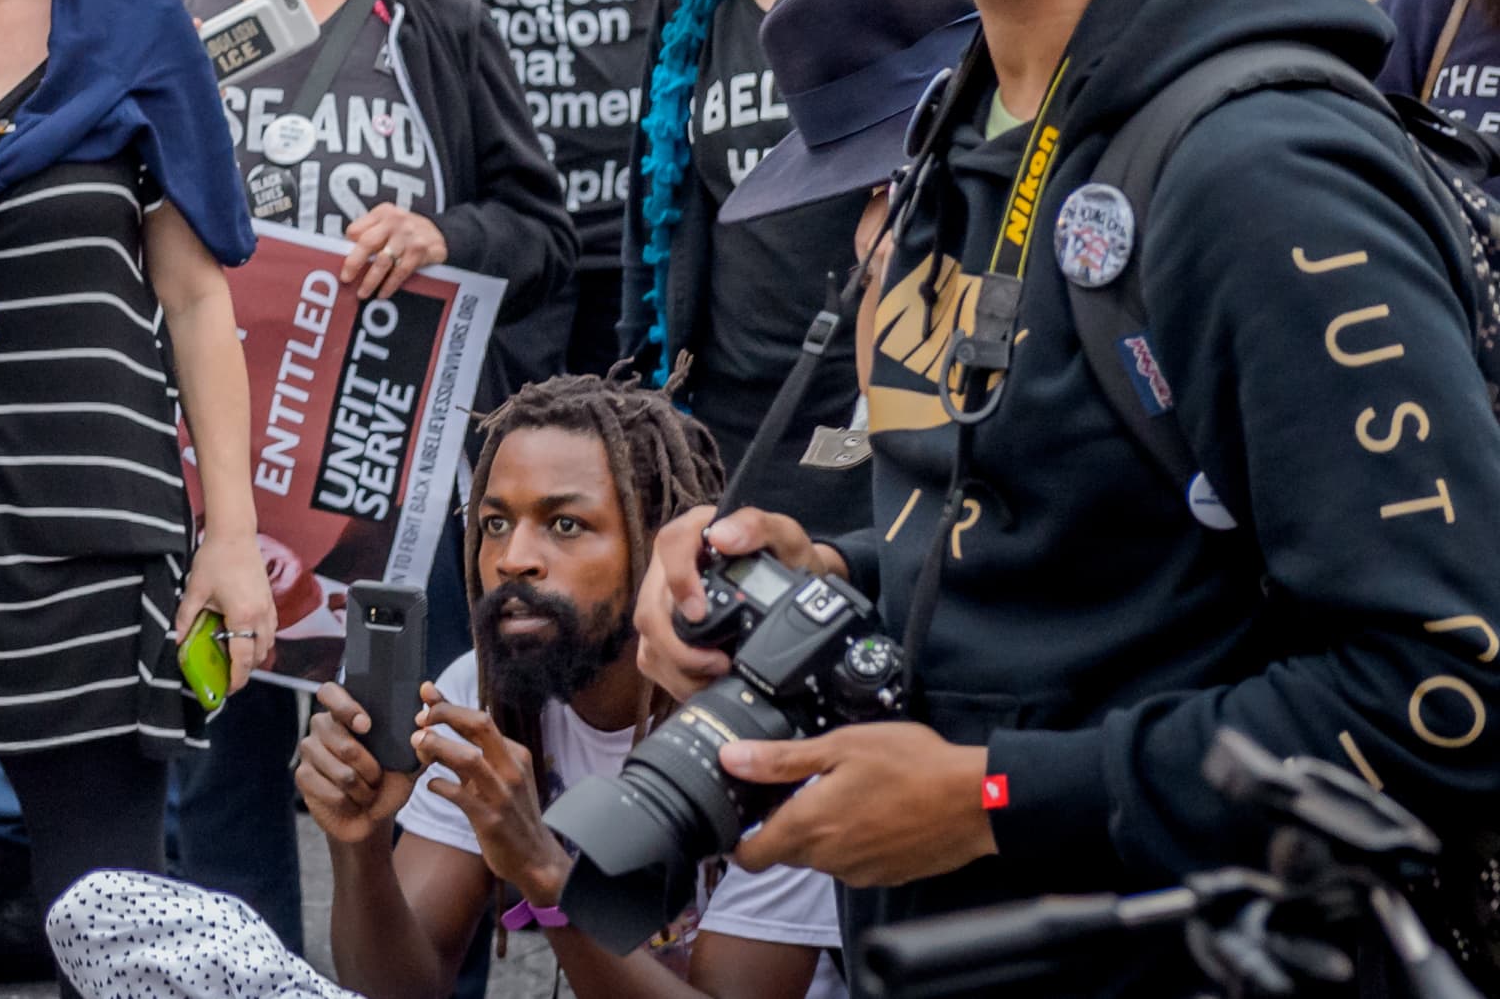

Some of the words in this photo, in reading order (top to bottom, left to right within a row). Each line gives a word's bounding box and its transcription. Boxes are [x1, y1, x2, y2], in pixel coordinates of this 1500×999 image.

[310, 92, 427, 170] AND
[1004, 124, 1061, 247] Nikon
[255, 269, 340, 497] ENTITLED
[318, 361, 380, 510] UNFIT
[351, 297, 399, 362] TO
[353, 377, 416, 521] SERVE
[1291, 246, 1456, 524] JUST
